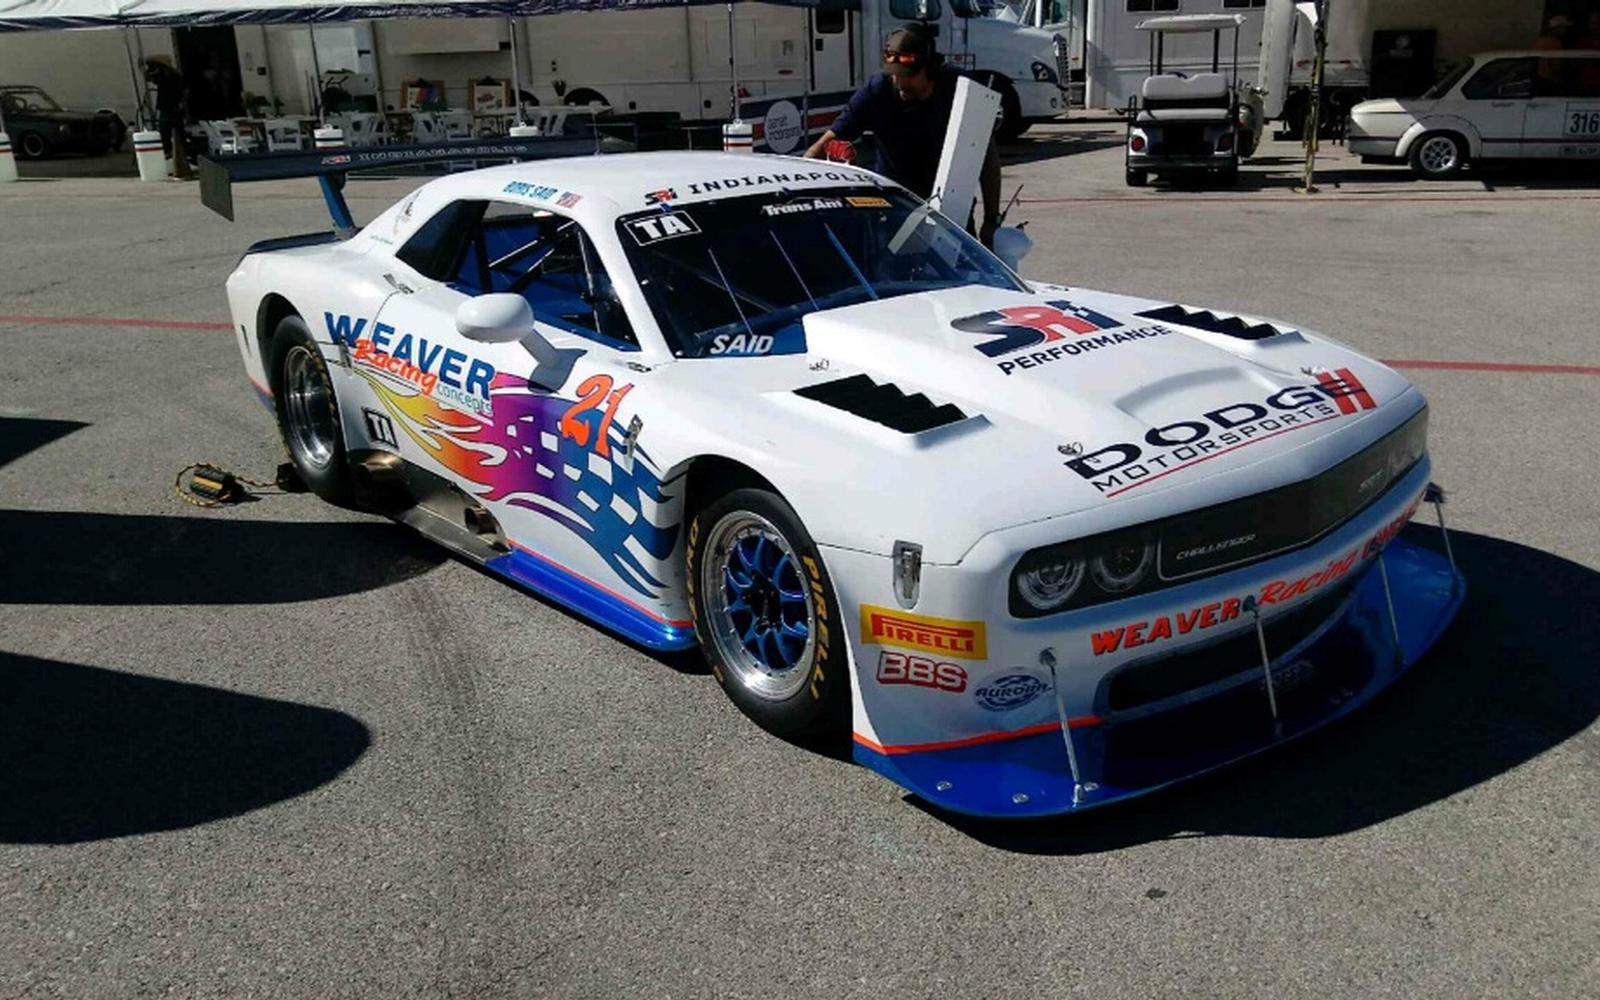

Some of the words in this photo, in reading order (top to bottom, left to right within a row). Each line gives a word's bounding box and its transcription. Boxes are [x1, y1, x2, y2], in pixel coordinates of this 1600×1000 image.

[1570, 112, 1600, 134] 316
[633, 216, 692, 239] TA
[323, 311, 496, 401] WEAVER
[354, 338, 438, 397] Racing
[709, 334, 774, 354] SAID
[997, 324, 1172, 376] PERFORMANCE
[436, 383, 493, 415] concepts
[561, 373, 635, 458] 21
[1063, 378, 1366, 479] DODGE
[1090, 404, 1335, 492] MOTORSPORTS
[1091, 597, 1241, 656] WEAVER
[1257, 549, 1360, 606] Racing
[871, 613, 975, 653] PIRELLI
[877, 650, 969, 694] BBS
